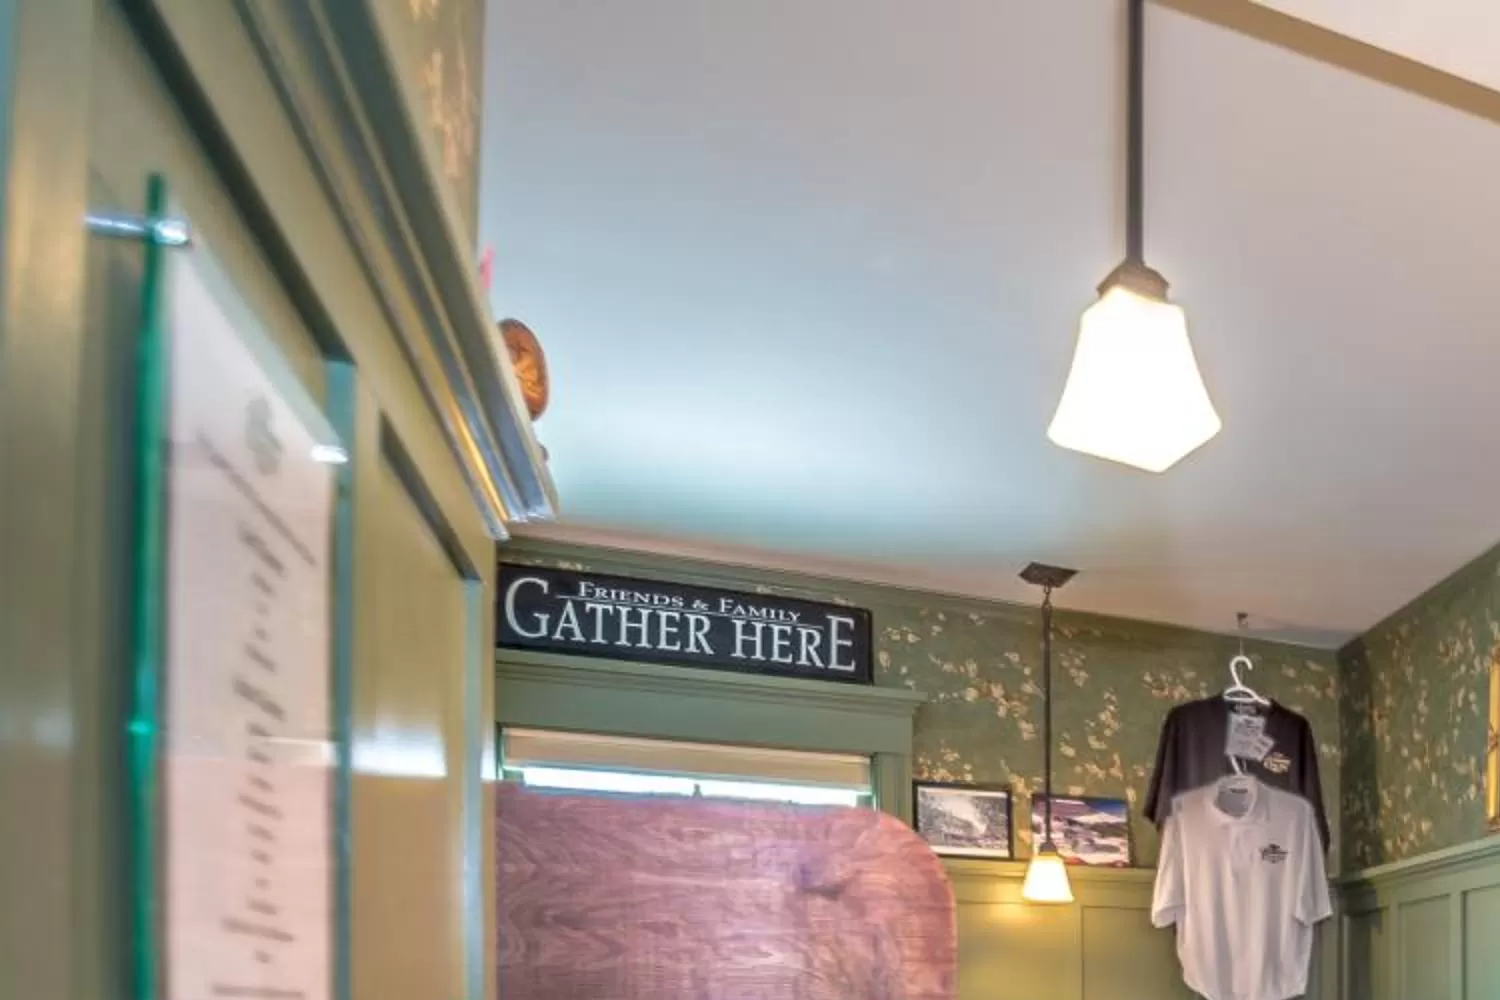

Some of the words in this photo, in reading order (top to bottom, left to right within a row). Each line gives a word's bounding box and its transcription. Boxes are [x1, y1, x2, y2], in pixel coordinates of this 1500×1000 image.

[504, 576, 715, 655] GATHER
[730, 613, 856, 672] HERE
[578, 580, 685, 607] FRIENDS
[692, 599, 710, 611] &
[718, 597, 802, 623] FAMILY
